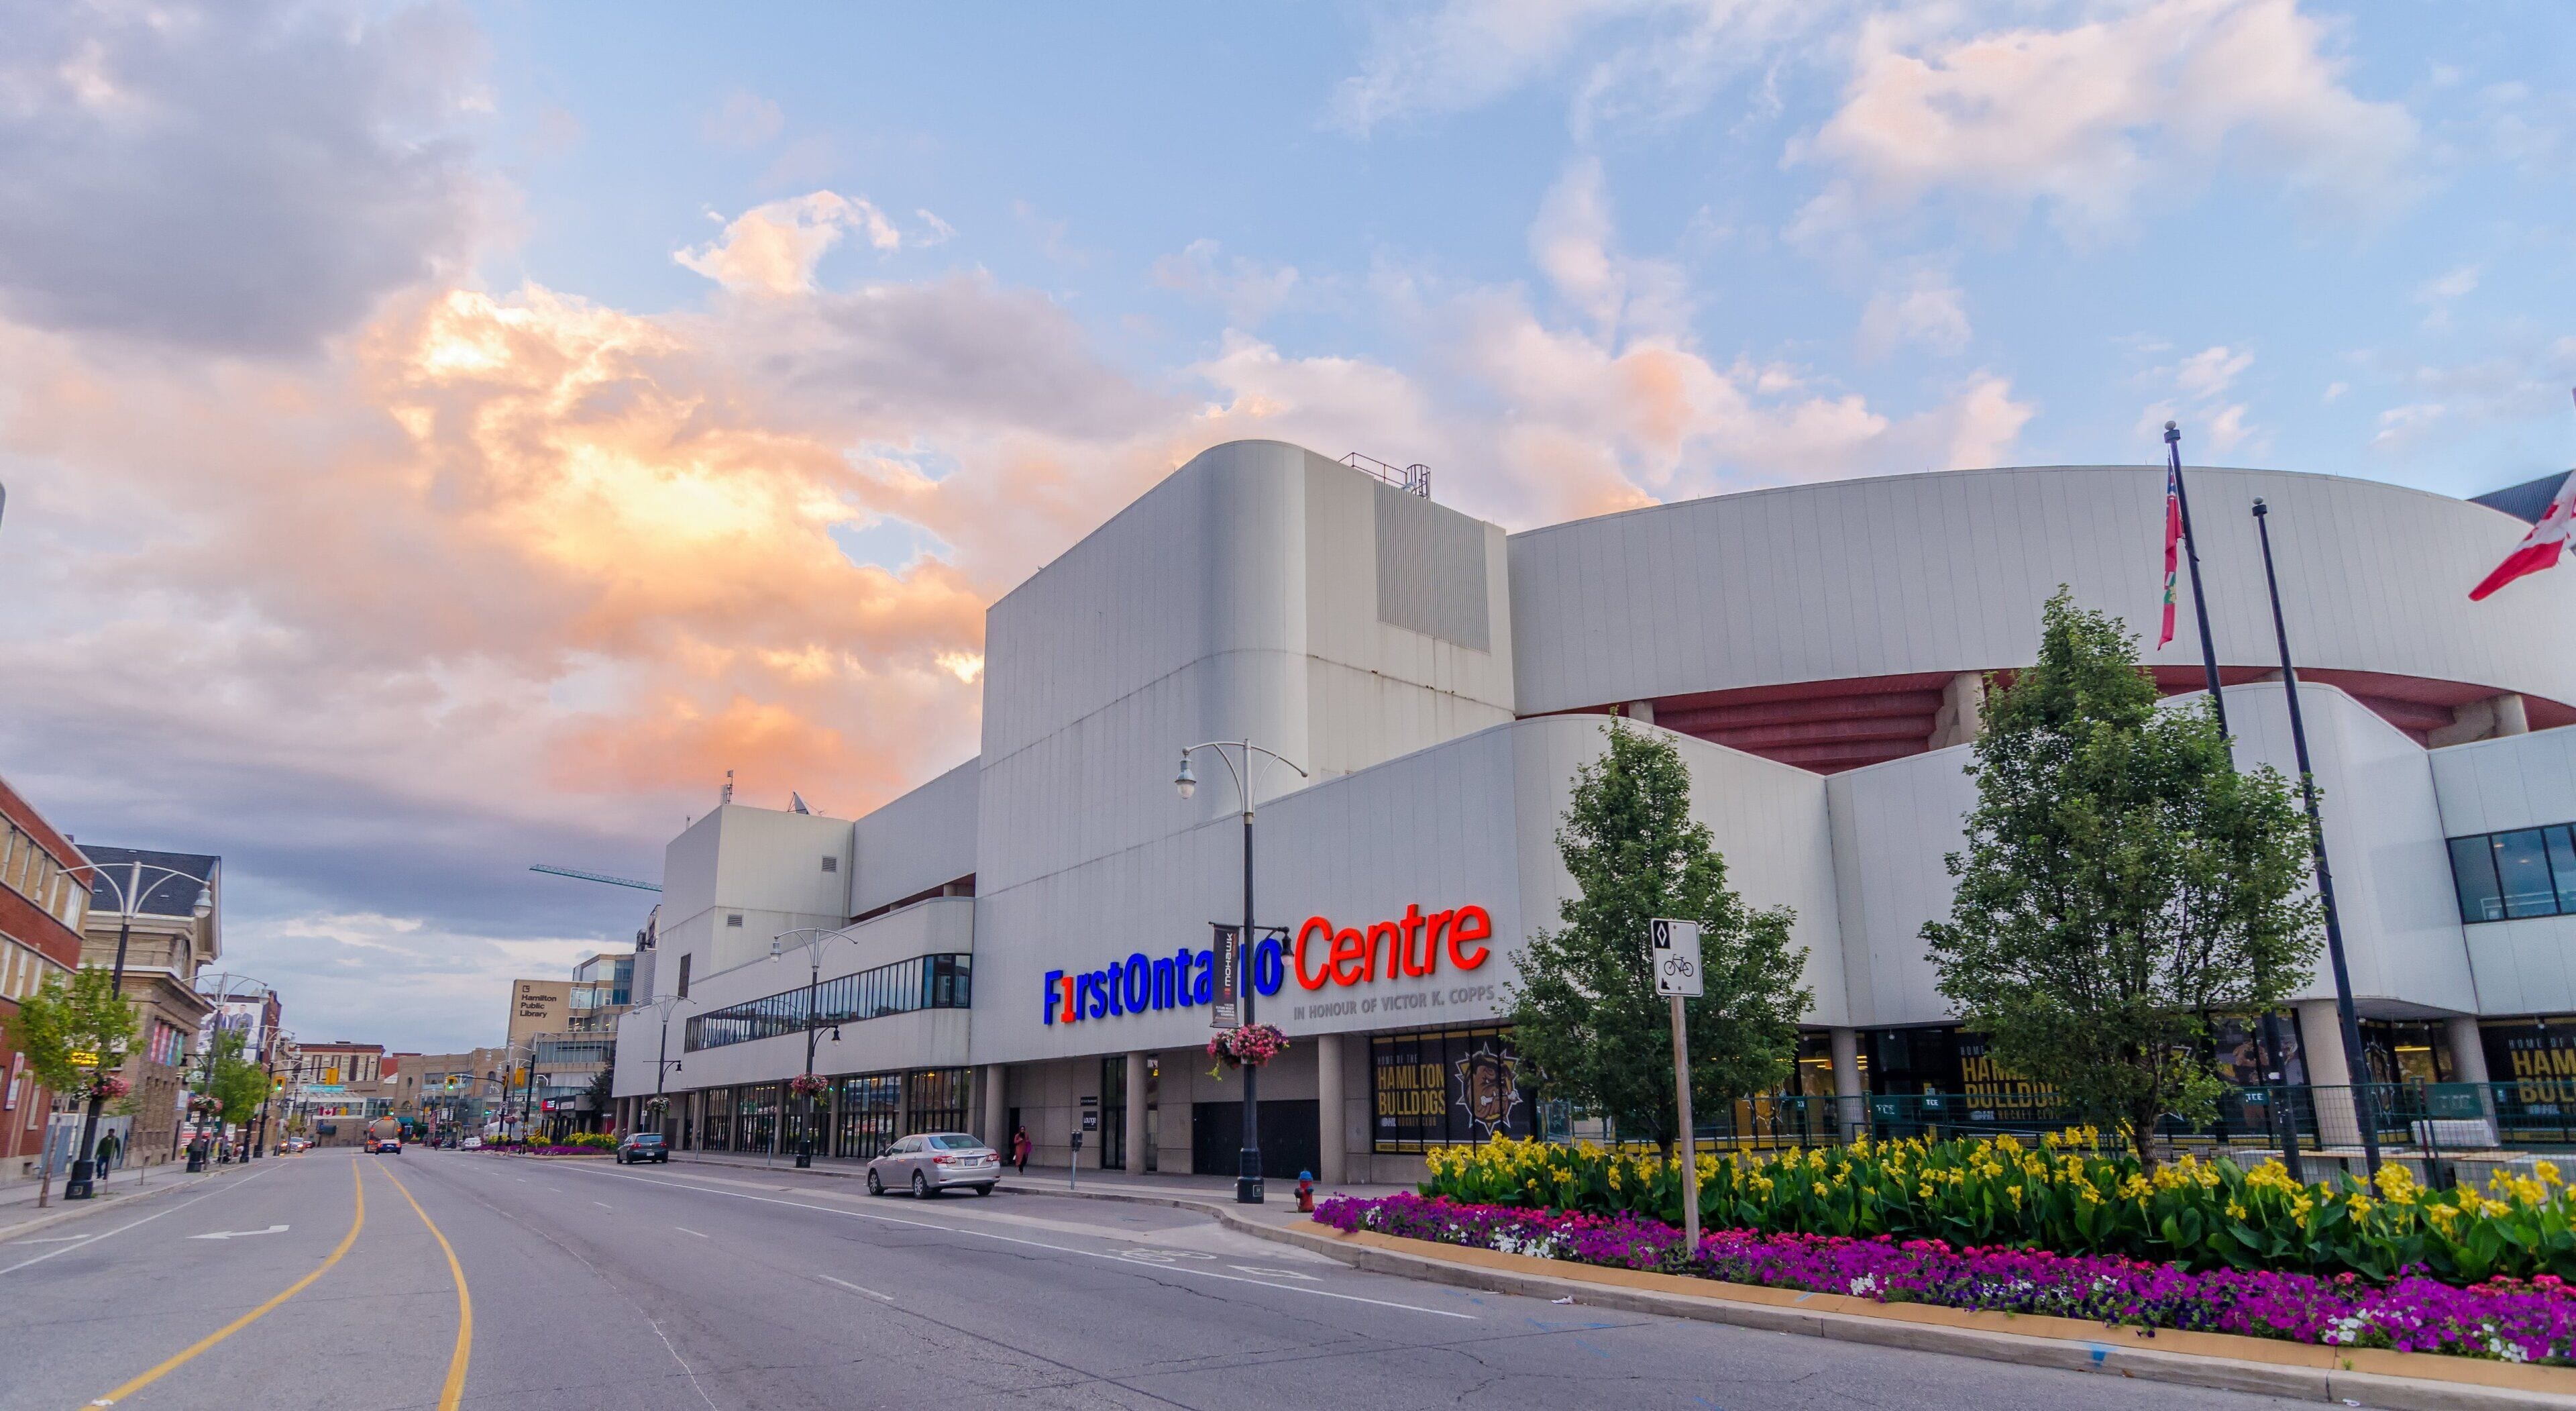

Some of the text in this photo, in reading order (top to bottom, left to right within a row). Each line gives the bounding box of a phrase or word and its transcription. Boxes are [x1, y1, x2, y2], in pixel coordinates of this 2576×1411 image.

[1044, 903, 1492, 1025] F1rstOntao Centre
[520, 1010, 547, 1018] Library
[1294, 984, 1495, 1020] IN HONOUR OF VICTOR K. COPPS
[1378, 1063, 1445, 1090] HAMILTON
[1379, 1090, 1446, 1115] BULLDOGS
[1965, 1082, 2062, 1108] BULLDOG
